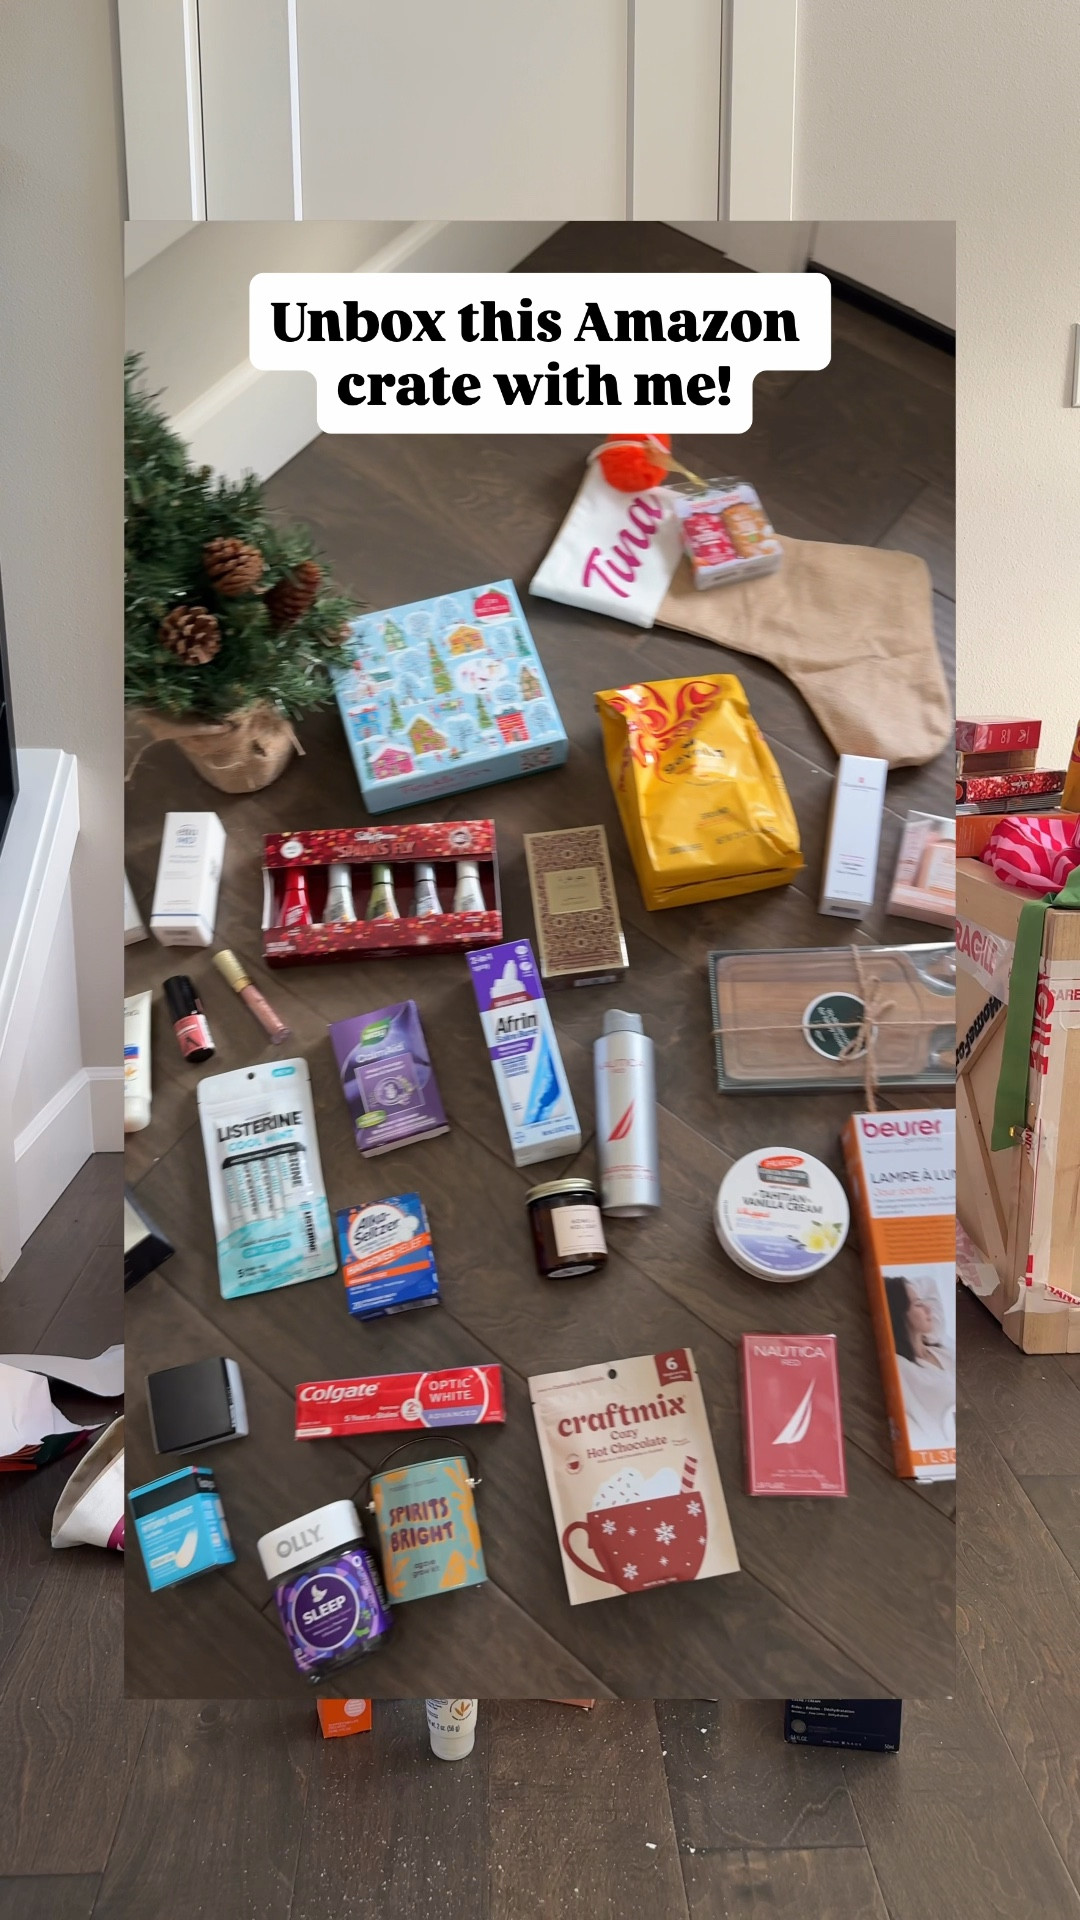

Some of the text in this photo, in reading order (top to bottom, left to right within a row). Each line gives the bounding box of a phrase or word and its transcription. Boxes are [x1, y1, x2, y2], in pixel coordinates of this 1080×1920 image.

[582, 494, 664, 598] Tina
[956, 919, 998, 977] RAGILE
[495, 1012, 537, 1036] Afrin
[216, 1110, 304, 1143] LISTERINE
[860, 1118, 942, 1138] beurer
[870, 1169, 920, 1185] LAMPE
[934, 1169, 956, 1181] LU
[665, 1357, 678, 1370] 6
[753, 1345, 827, 1359] NAUTICA
[300, 1383, 379, 1405] Colgate
[428, 1377, 471, 1391] OPTIC
[428, 1390, 472, 1403] WHITE
[558, 1393, 687, 1437] craftmix
[610, 1428, 639, 1441] Cozy
[586, 1435, 668, 1460] Hot Chocolate
[389, 1496, 450, 1527] SPIRITS
[390, 1521, 454, 1553] BRIGHT
[302, 1594, 347, 1625] SLEEP
